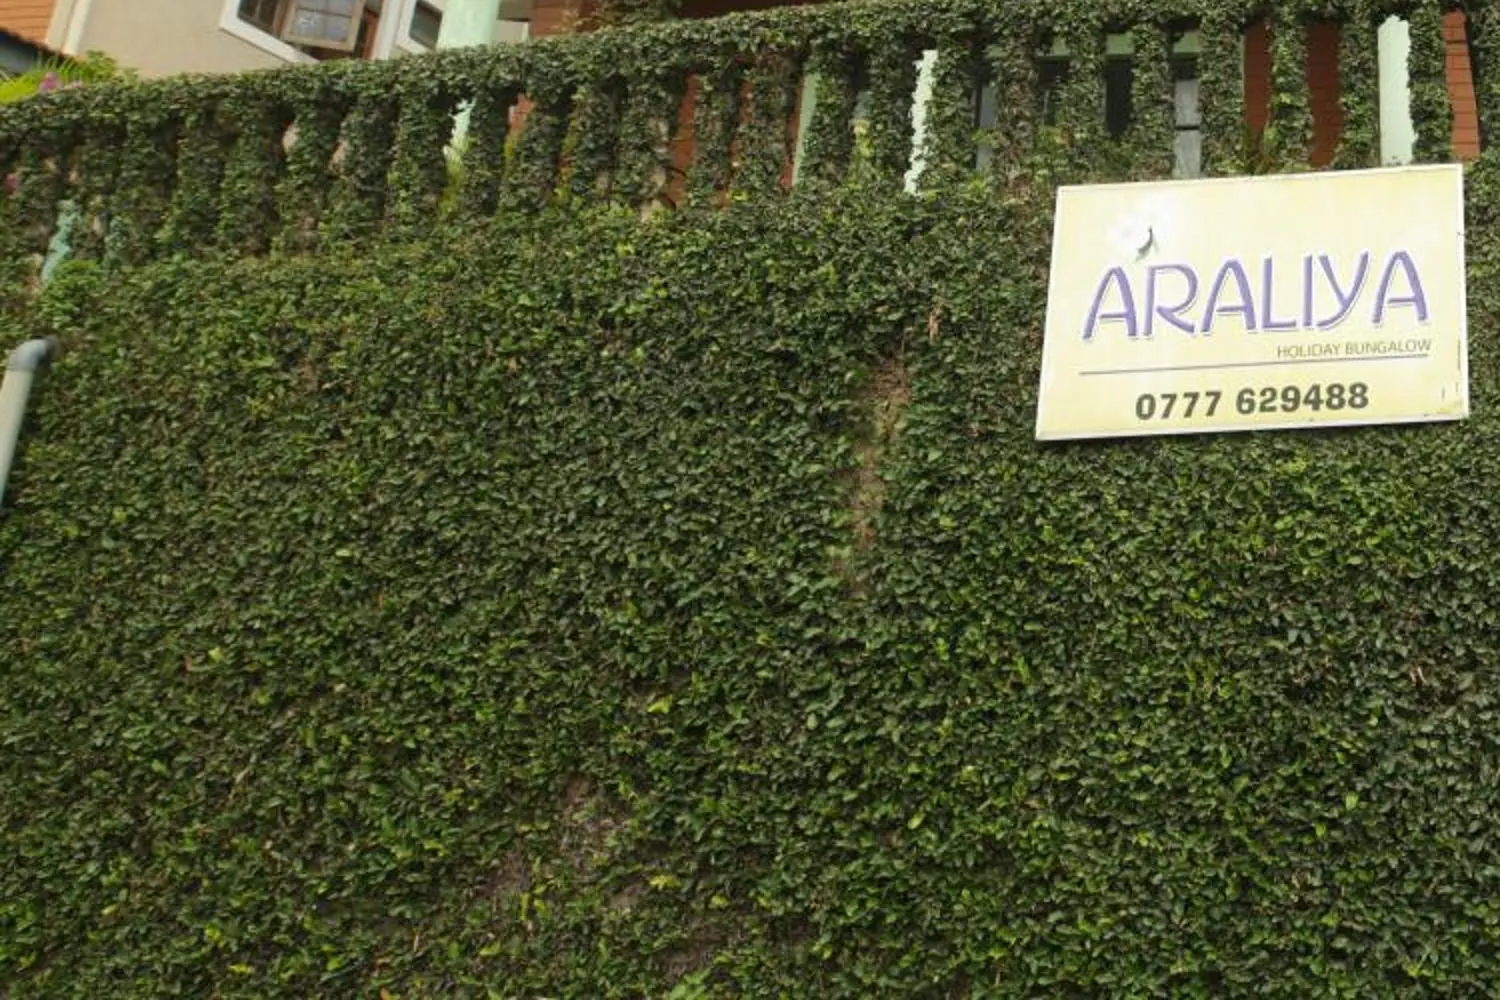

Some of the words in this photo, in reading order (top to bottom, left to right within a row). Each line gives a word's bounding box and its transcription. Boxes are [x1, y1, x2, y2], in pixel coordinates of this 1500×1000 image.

[1082, 250, 1428, 339] ARALIYA
[1277, 343, 1341, 359] HOLIDAY
[1345, 338, 1432, 356] BUNGALOW
[1135, 390, 1222, 420] 0777
[1235, 381, 1369, 415] 629488
